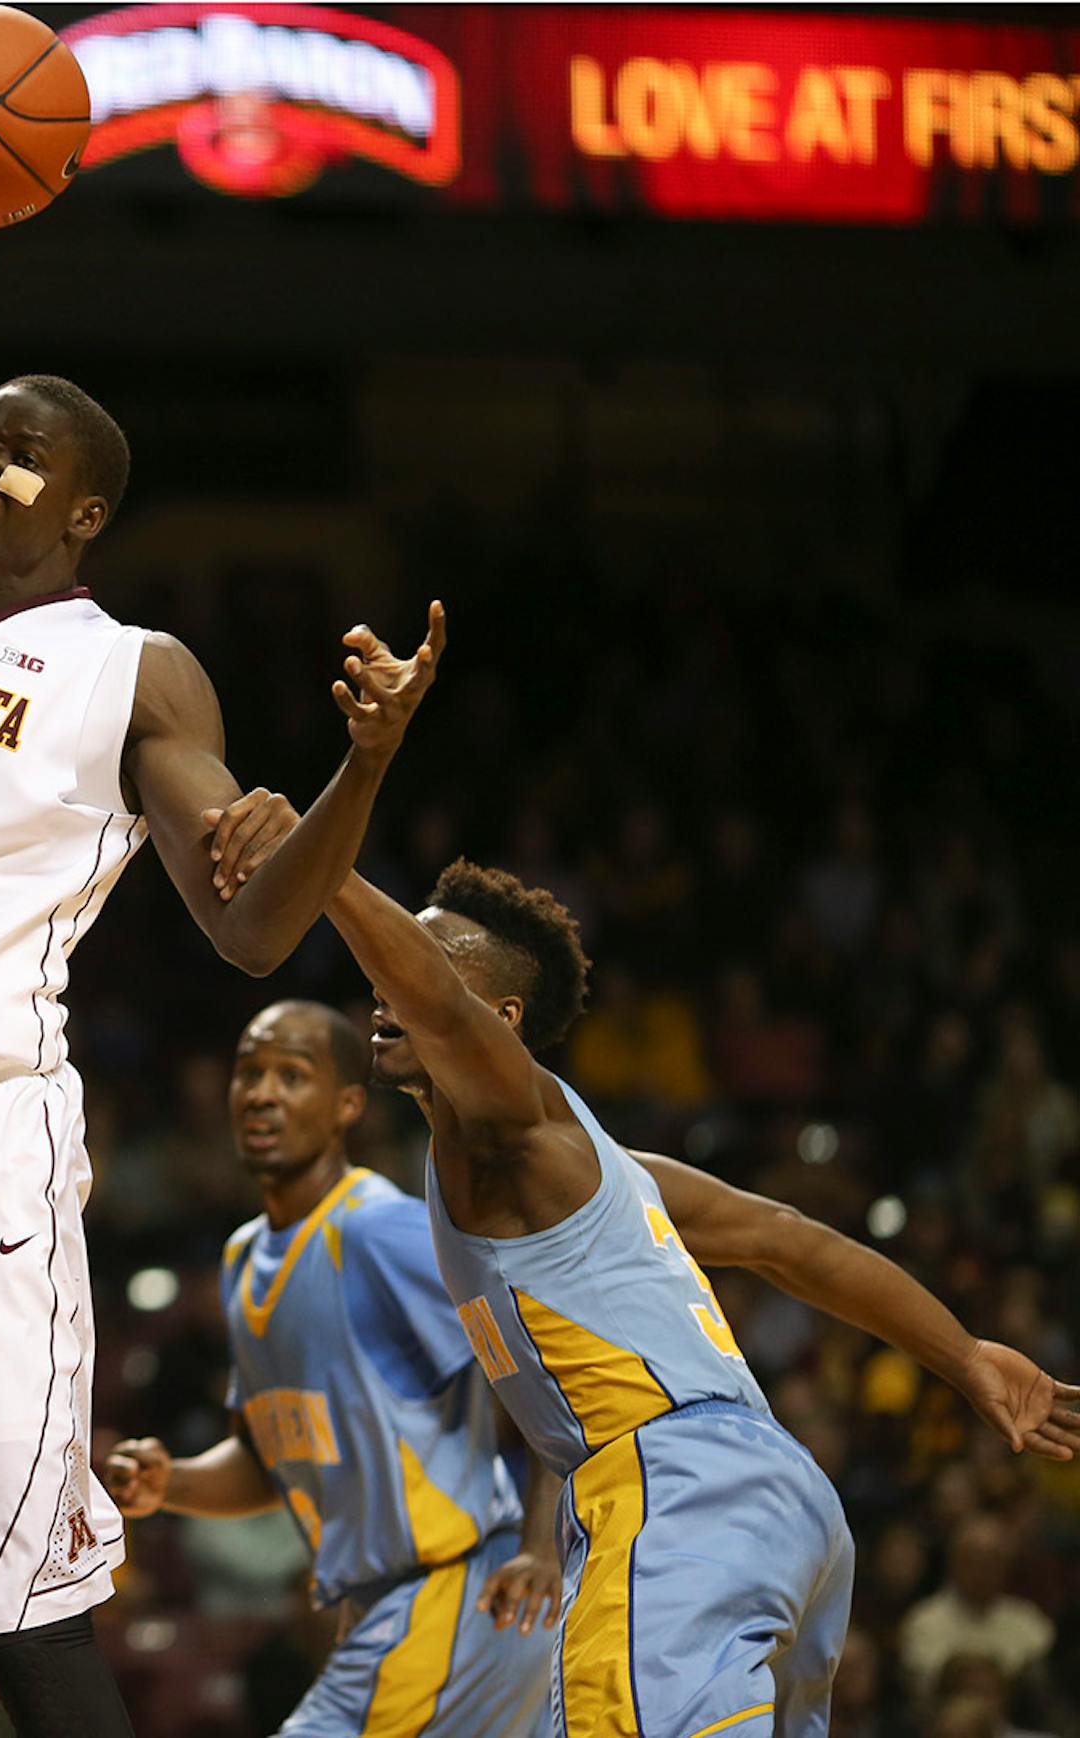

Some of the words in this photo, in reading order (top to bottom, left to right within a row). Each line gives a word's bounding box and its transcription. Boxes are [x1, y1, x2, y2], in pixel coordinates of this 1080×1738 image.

[570, 55, 781, 161] LOVE
[785, 65, 892, 165] AT
[902, 68, 1080, 174] FIRS
